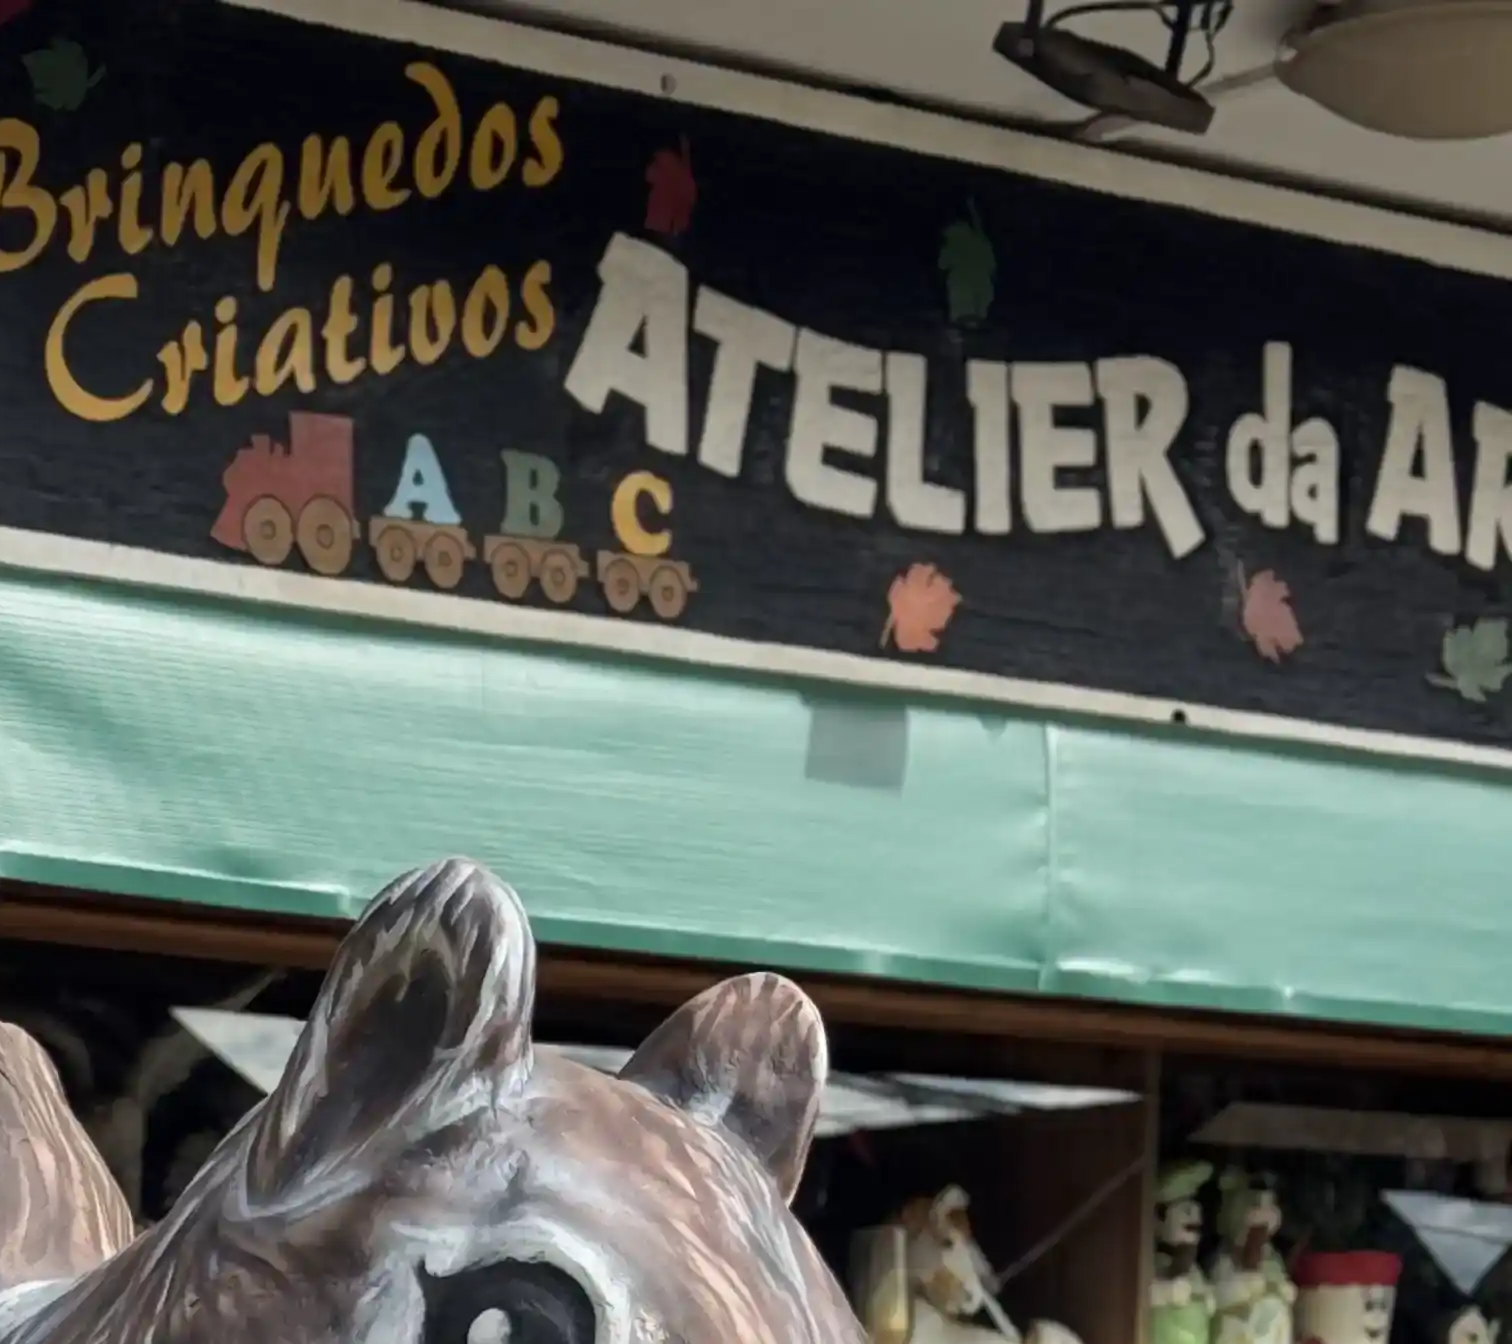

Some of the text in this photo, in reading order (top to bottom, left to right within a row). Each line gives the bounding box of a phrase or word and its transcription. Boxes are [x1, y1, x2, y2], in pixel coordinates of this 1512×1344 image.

[44, 260, 555, 421] Criativos
[563, 231, 1205, 560] ATELIER
[1225, 340, 1339, 544] da
[383, 434, 672, 555] A B C
